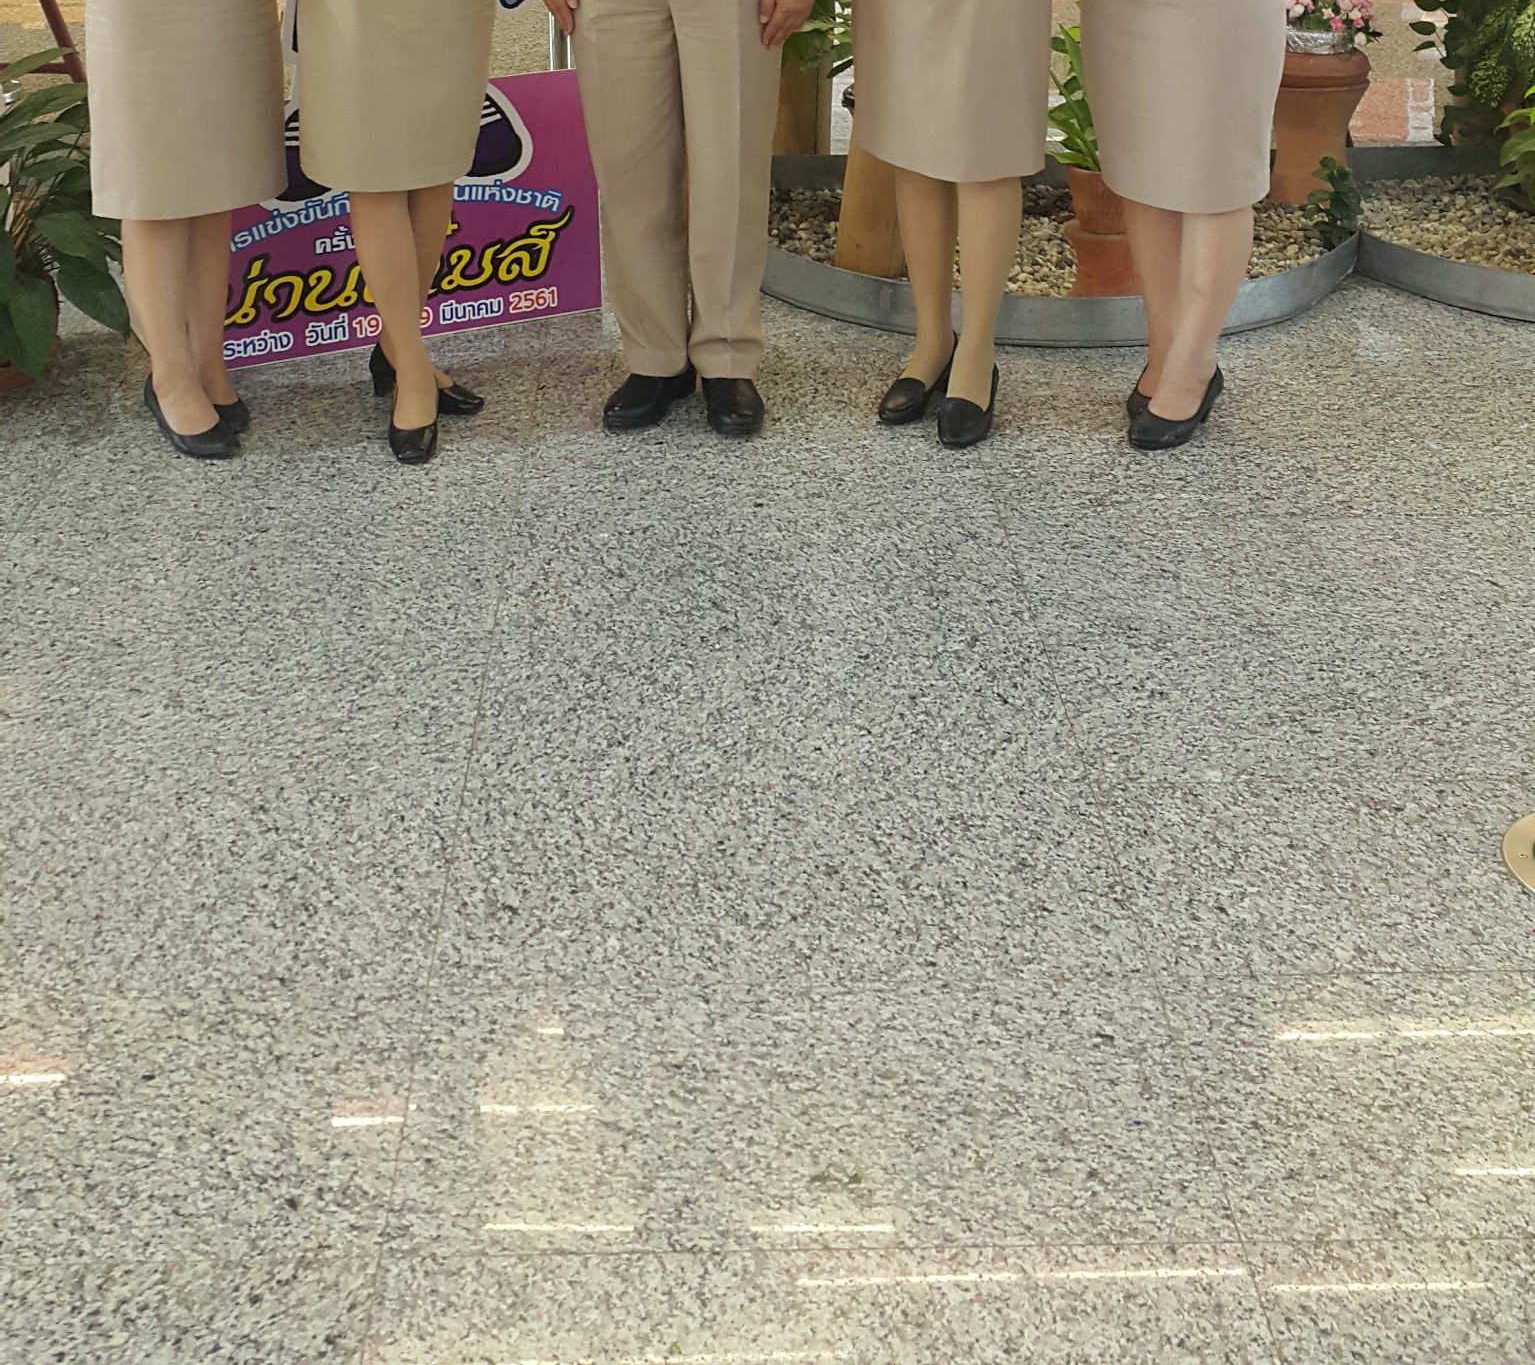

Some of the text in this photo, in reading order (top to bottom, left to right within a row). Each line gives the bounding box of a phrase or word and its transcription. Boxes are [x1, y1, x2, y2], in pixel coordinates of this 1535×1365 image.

[352, 314, 383, 338] 19
[439, 297, 503, 325] มีนาคม
[508, 286, 558, 314] 2561
